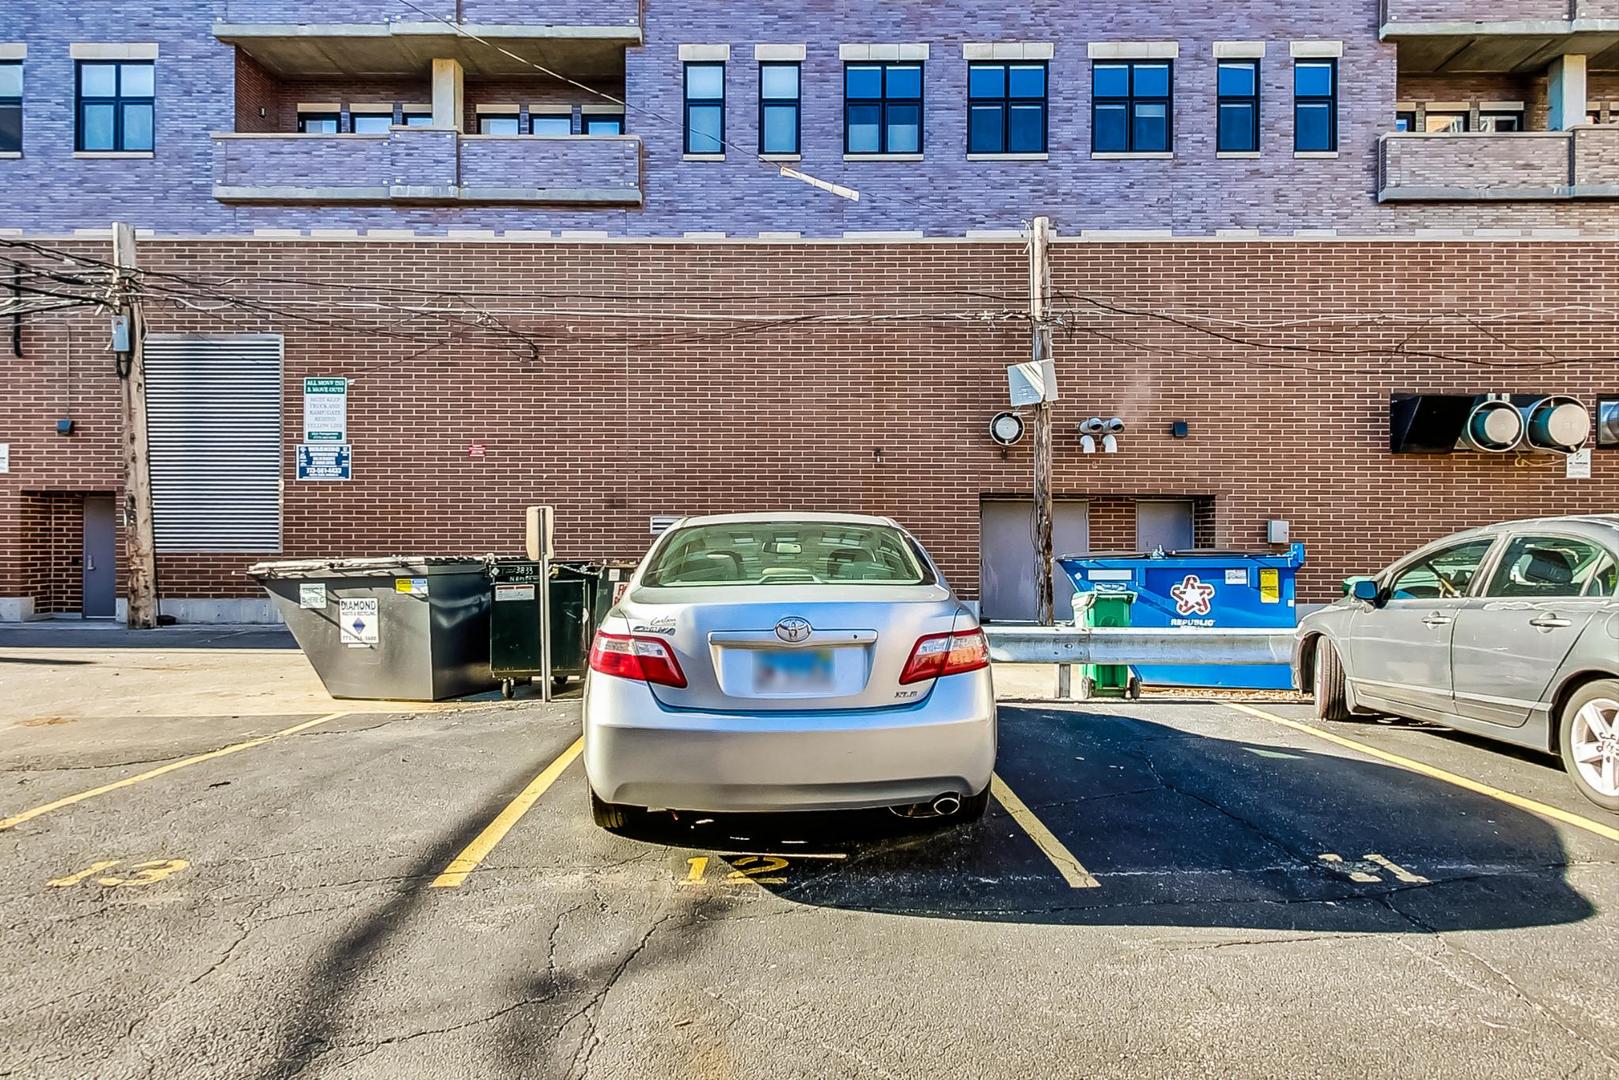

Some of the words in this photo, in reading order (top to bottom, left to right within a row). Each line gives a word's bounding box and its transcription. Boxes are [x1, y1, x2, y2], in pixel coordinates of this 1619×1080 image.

[341, 600, 376, 610] DIAMOND
[1171, 618, 1214, 626] REPUBLIC
[46, 858, 189, 888] 13
[681, 855, 790, 885] 12
